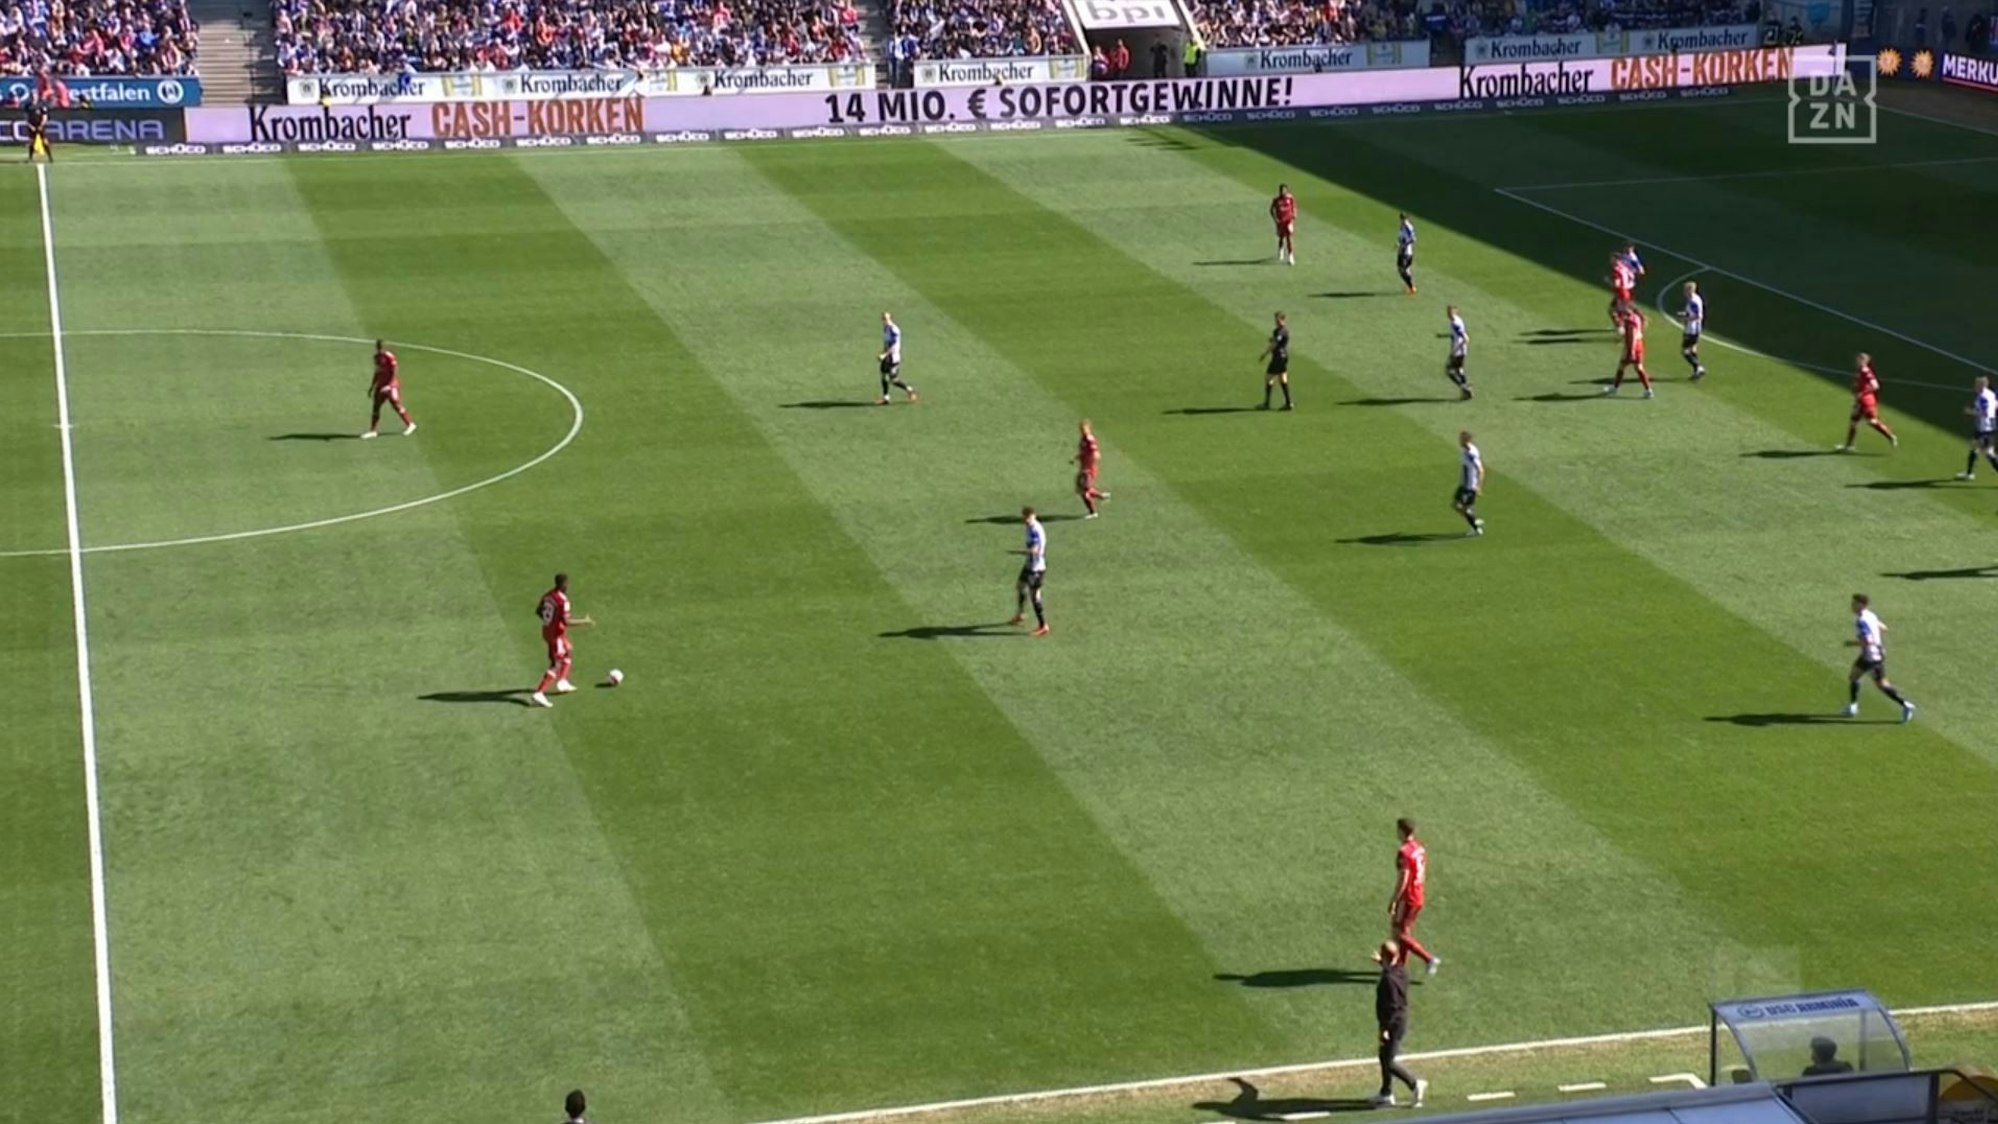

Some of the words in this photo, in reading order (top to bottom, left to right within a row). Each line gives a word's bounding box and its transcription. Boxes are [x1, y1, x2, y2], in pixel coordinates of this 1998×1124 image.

[1491, 39, 1581, 59] Krombacher
[1657, 29, 1750, 51] Krombacher
[1260, 48, 1352, 69] Krombacher
[714, 68, 815, 88] Krombacher
[939, 61, 1034, 81] Krombacher
[1459, 61, 1594, 99] Krombacher
[1610, 47, 1795, 91] CASH-KORKEN
[1942, 52, 1998, 87] MERKU
[319, 77, 425, 98] Krombacher
[519, 73, 626, 94] Krombacher
[824, 93, 867, 124] 14
[878, 90, 957, 122] MIO.
[967, 88, 988, 120] €
[1000, 77, 1293, 120] SOFORTGEWINNE!
[249, 103, 411, 142] Krombacher
[431, 97, 644, 141] CASH-KORKEN
